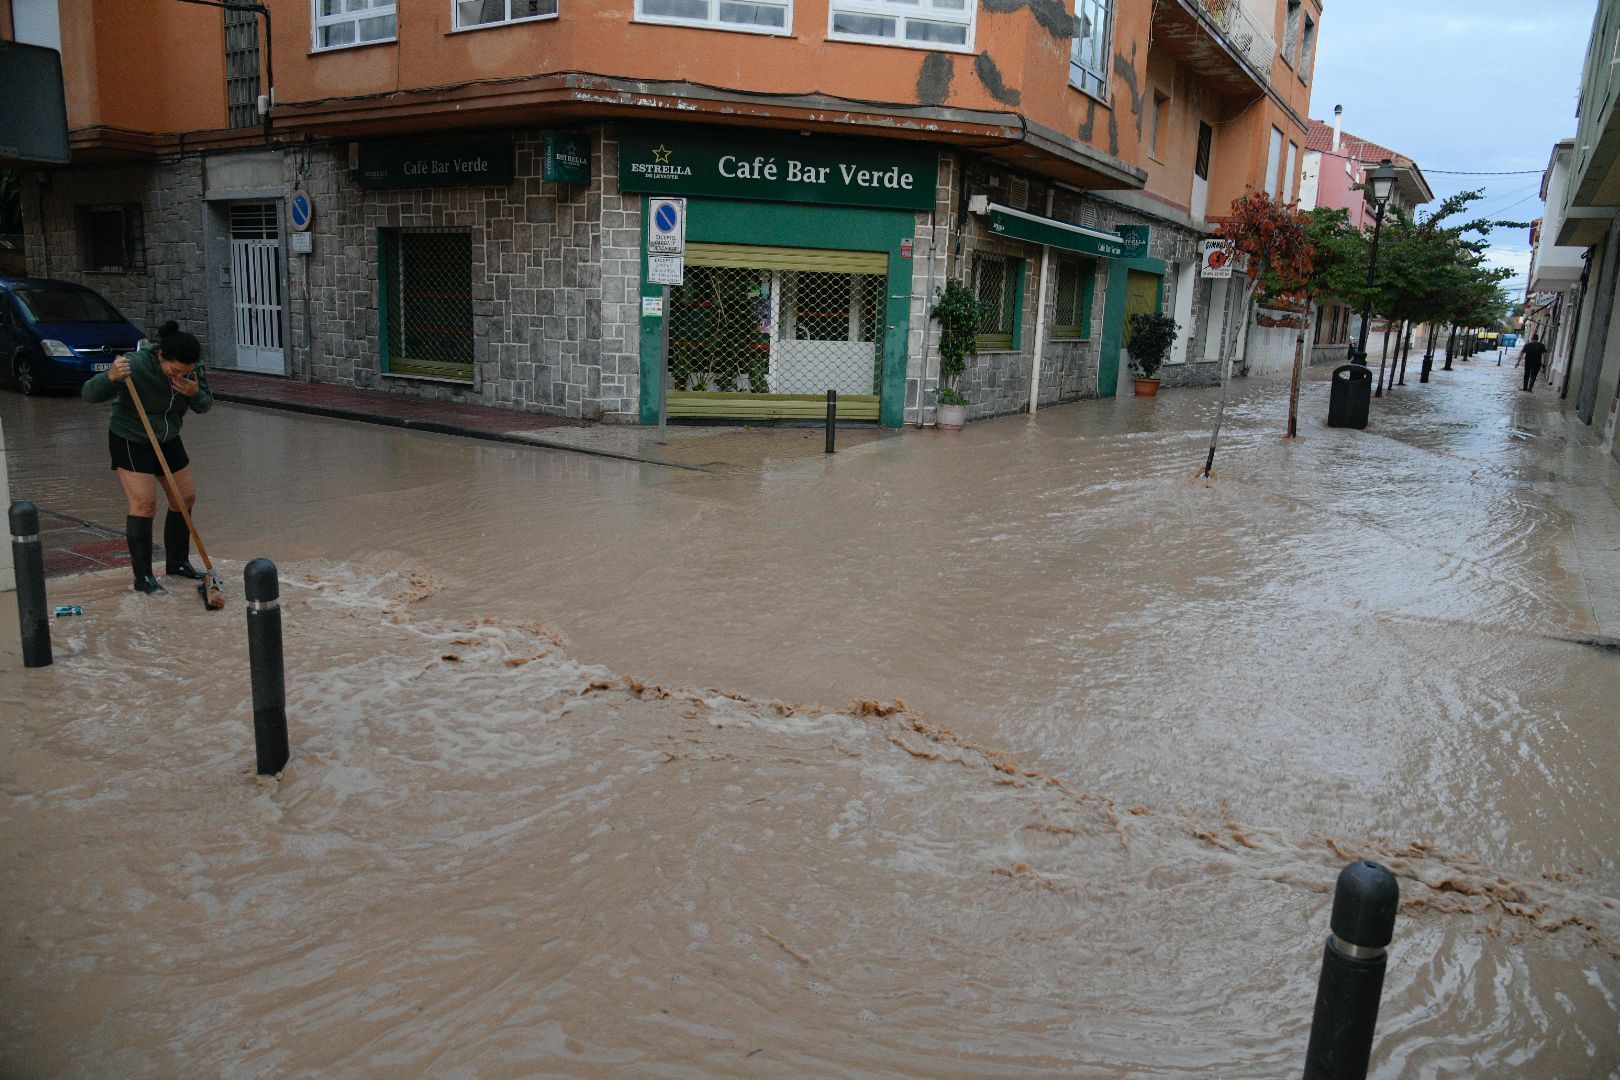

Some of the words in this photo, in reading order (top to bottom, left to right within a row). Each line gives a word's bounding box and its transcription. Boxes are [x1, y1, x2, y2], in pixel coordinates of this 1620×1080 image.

[403, 160, 428, 175] Café
[431, 160, 450, 174] Bar
[453, 157, 488, 173] Verde
[556, 153, 587, 165] ESTRELLA
[632, 163, 692, 176] ESTRELLA
[718, 156, 777, 181] Café
[787, 160, 830, 184] Bar
[839, 164, 913, 189] Verde
